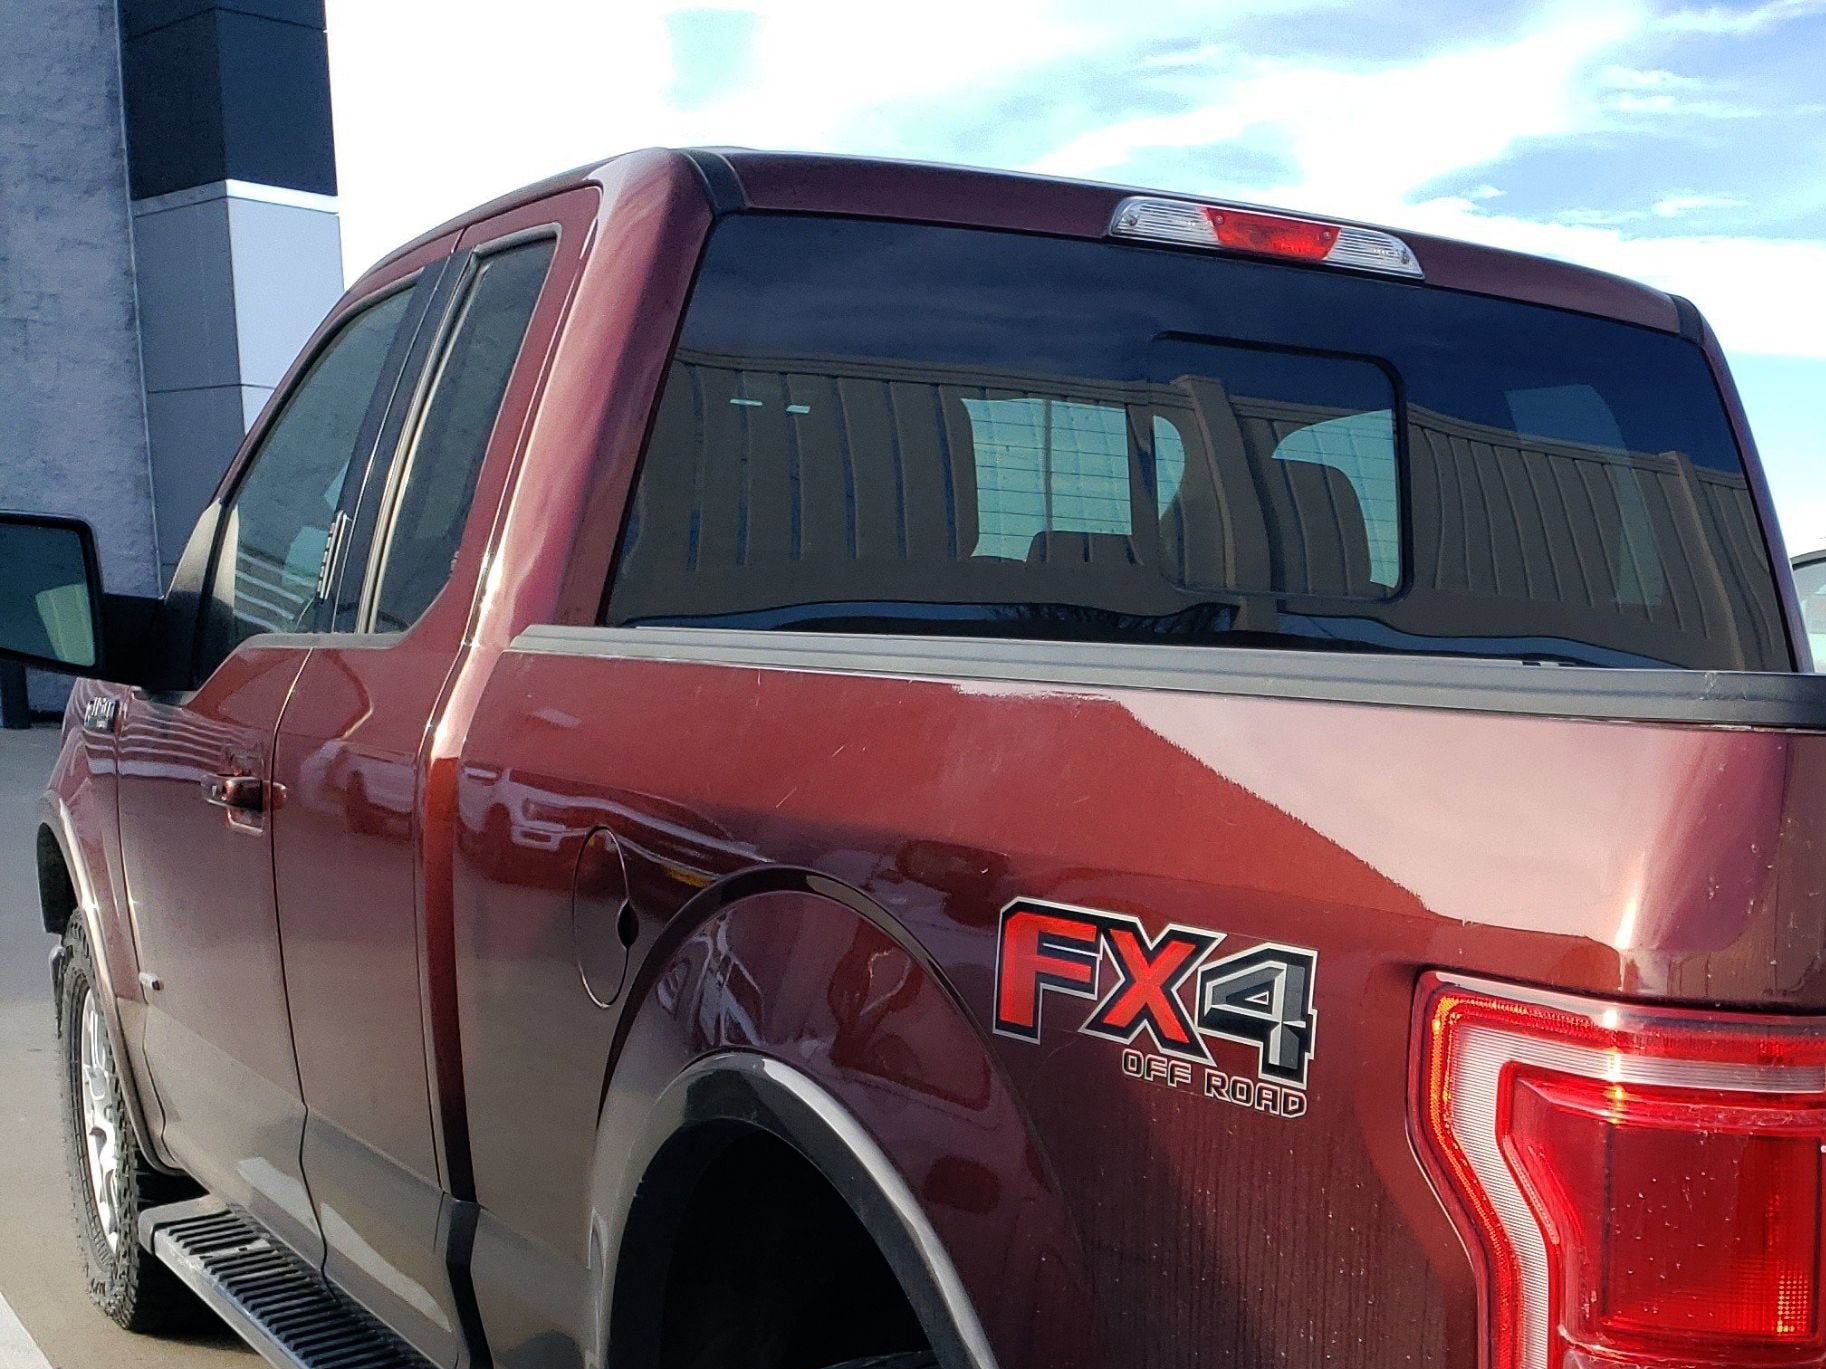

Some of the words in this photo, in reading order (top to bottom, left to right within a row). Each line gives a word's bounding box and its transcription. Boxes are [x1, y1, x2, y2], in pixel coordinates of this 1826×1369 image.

[993, 896, 1318, 1089] FX4
[1122, 1048, 1192, 1088] OFF
[1205, 1069, 1307, 1119] ROAD
